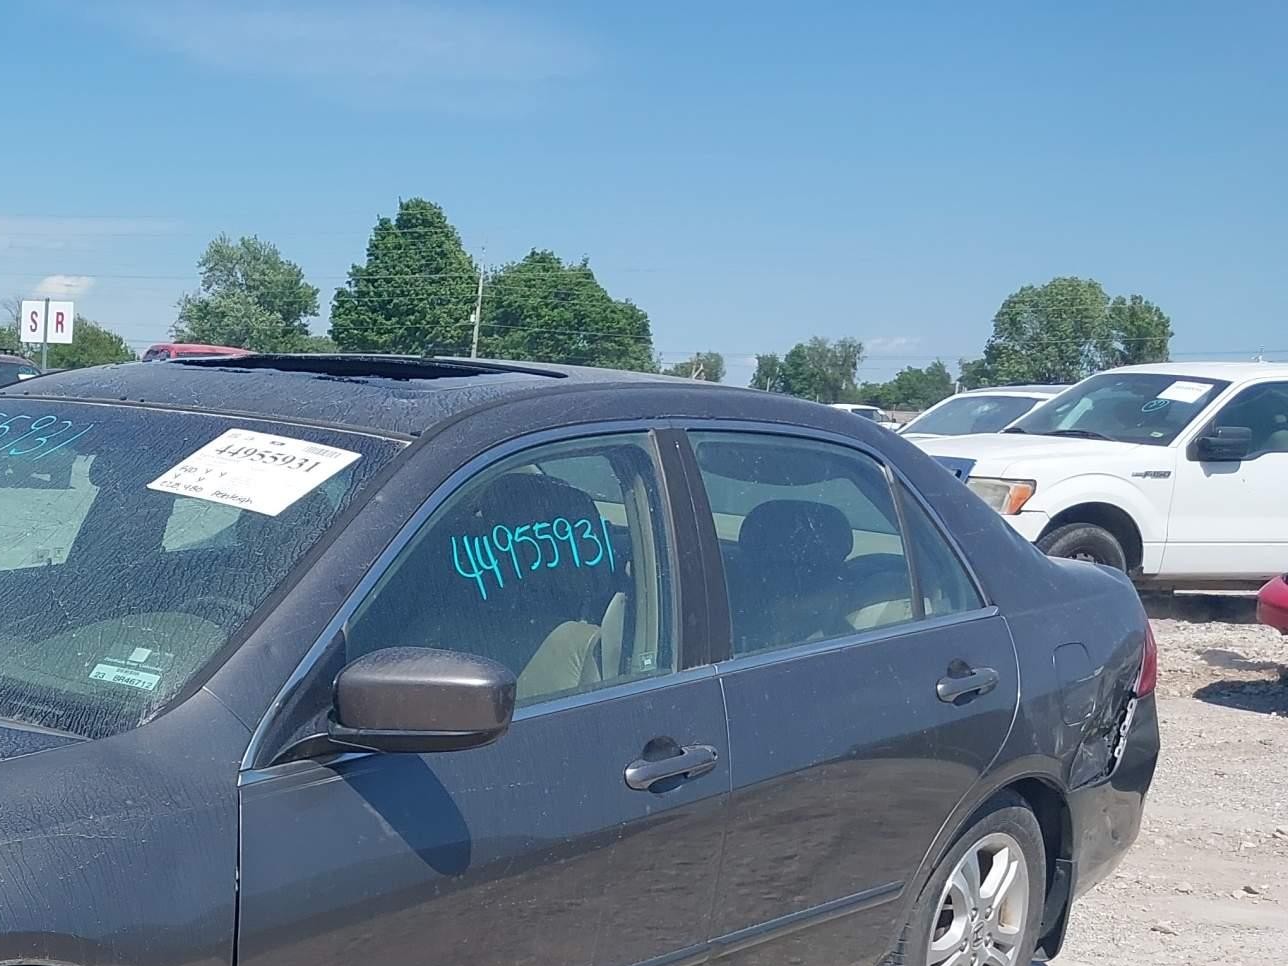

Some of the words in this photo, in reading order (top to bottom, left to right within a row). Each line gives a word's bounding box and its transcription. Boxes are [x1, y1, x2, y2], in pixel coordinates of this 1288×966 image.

[29, 310, 39, 333] S
[55, 311, 65, 334] R
[215, 443, 321, 474] 44955931
[450, 516, 615, 600] 44955931
[93, 671, 106, 679] 23
